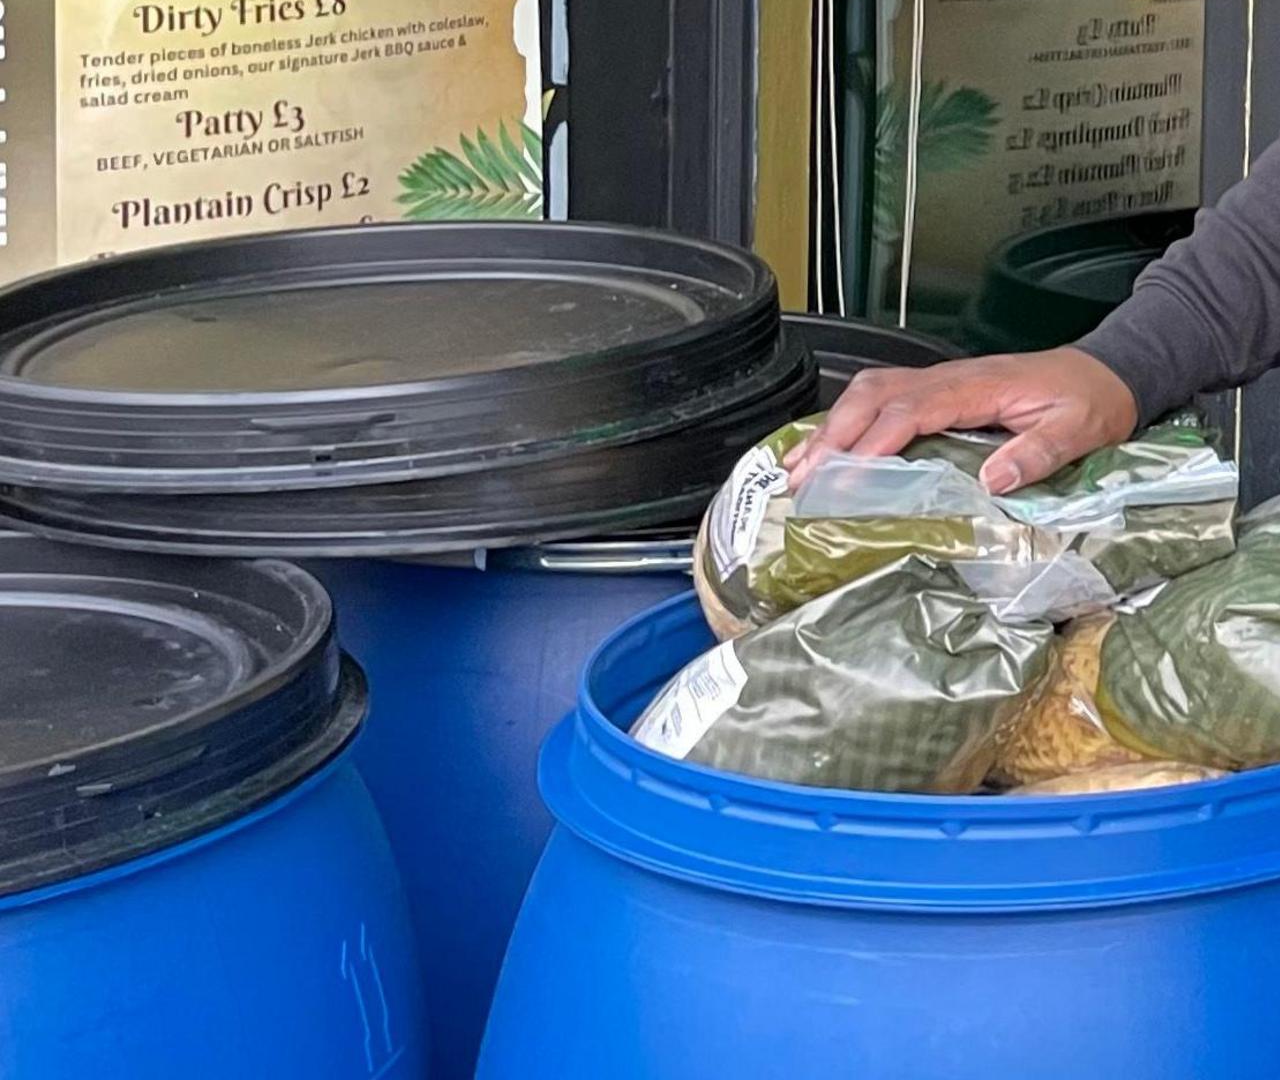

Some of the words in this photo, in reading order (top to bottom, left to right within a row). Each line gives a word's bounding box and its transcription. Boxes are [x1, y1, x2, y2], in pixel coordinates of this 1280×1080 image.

[81, 50, 144, 68] Tender
[150, 47, 205, 66] pieces
[210, 43, 227, 57] of
[231, 37, 301, 55] boneless
[305, 34, 336, 47] Jerk
[341, 26, 393, 44] chicken
[398, 21, 425, 36] with
[429, 14, 489, 32] coleslaw,
[133, 3, 222, 37] Dirty
[80, 73, 126, 88] fries,
[131, 68, 178, 85] dried
[183, 63, 243, 79] onions,
[248, 60, 274, 74] our
[279, 50, 348, 72] signature
[351, 46, 381, 61] Jerk
[385, 41, 413, 57] BBQ
[418, 39, 454, 53] sauce
[458, 36, 466, 47] &
[80, 92, 129, 109] salad
[134, 87, 189, 103] cream
[176, 107, 263, 138] Patty
[274, 99, 305, 131] £3
[97, 155, 148, 171] BEEF,
[154, 141, 263, 166] VEGETARIAN
[268, 139, 290, 153] OR
[294, 127, 364, 149] SALTFISH
[112, 191, 252, 229] Plantain
[264, 180, 332, 215] Crisp
[341, 171, 370, 200] £2
